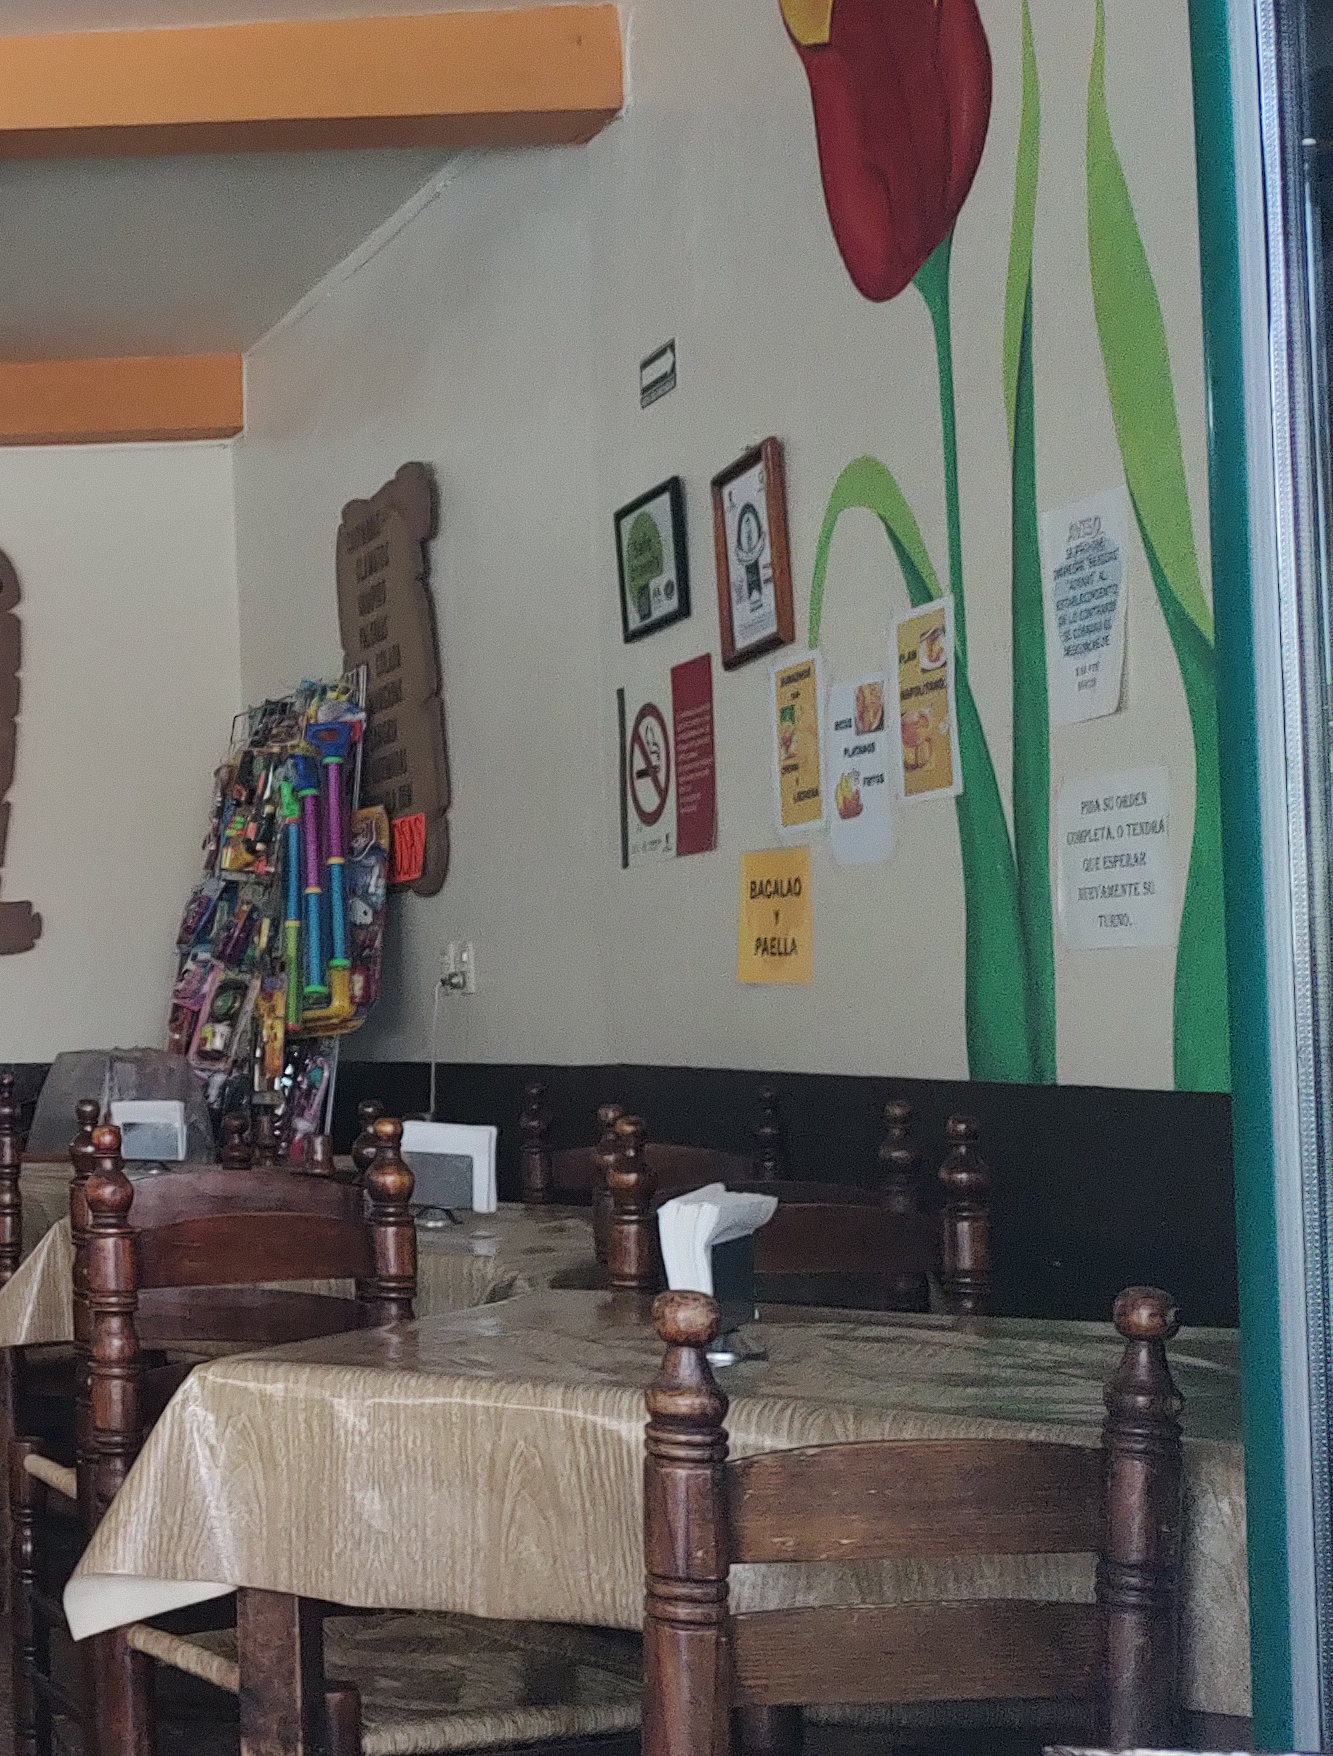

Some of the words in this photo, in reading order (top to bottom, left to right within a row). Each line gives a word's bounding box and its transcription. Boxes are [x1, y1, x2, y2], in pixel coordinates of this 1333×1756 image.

[1116, 791, 1147, 810] ORDEN
[1103, 852, 1147, 869] ESPERAR
[749, 876, 802, 899] BACALAO
[754, 936, 798, 957] PAELLA
